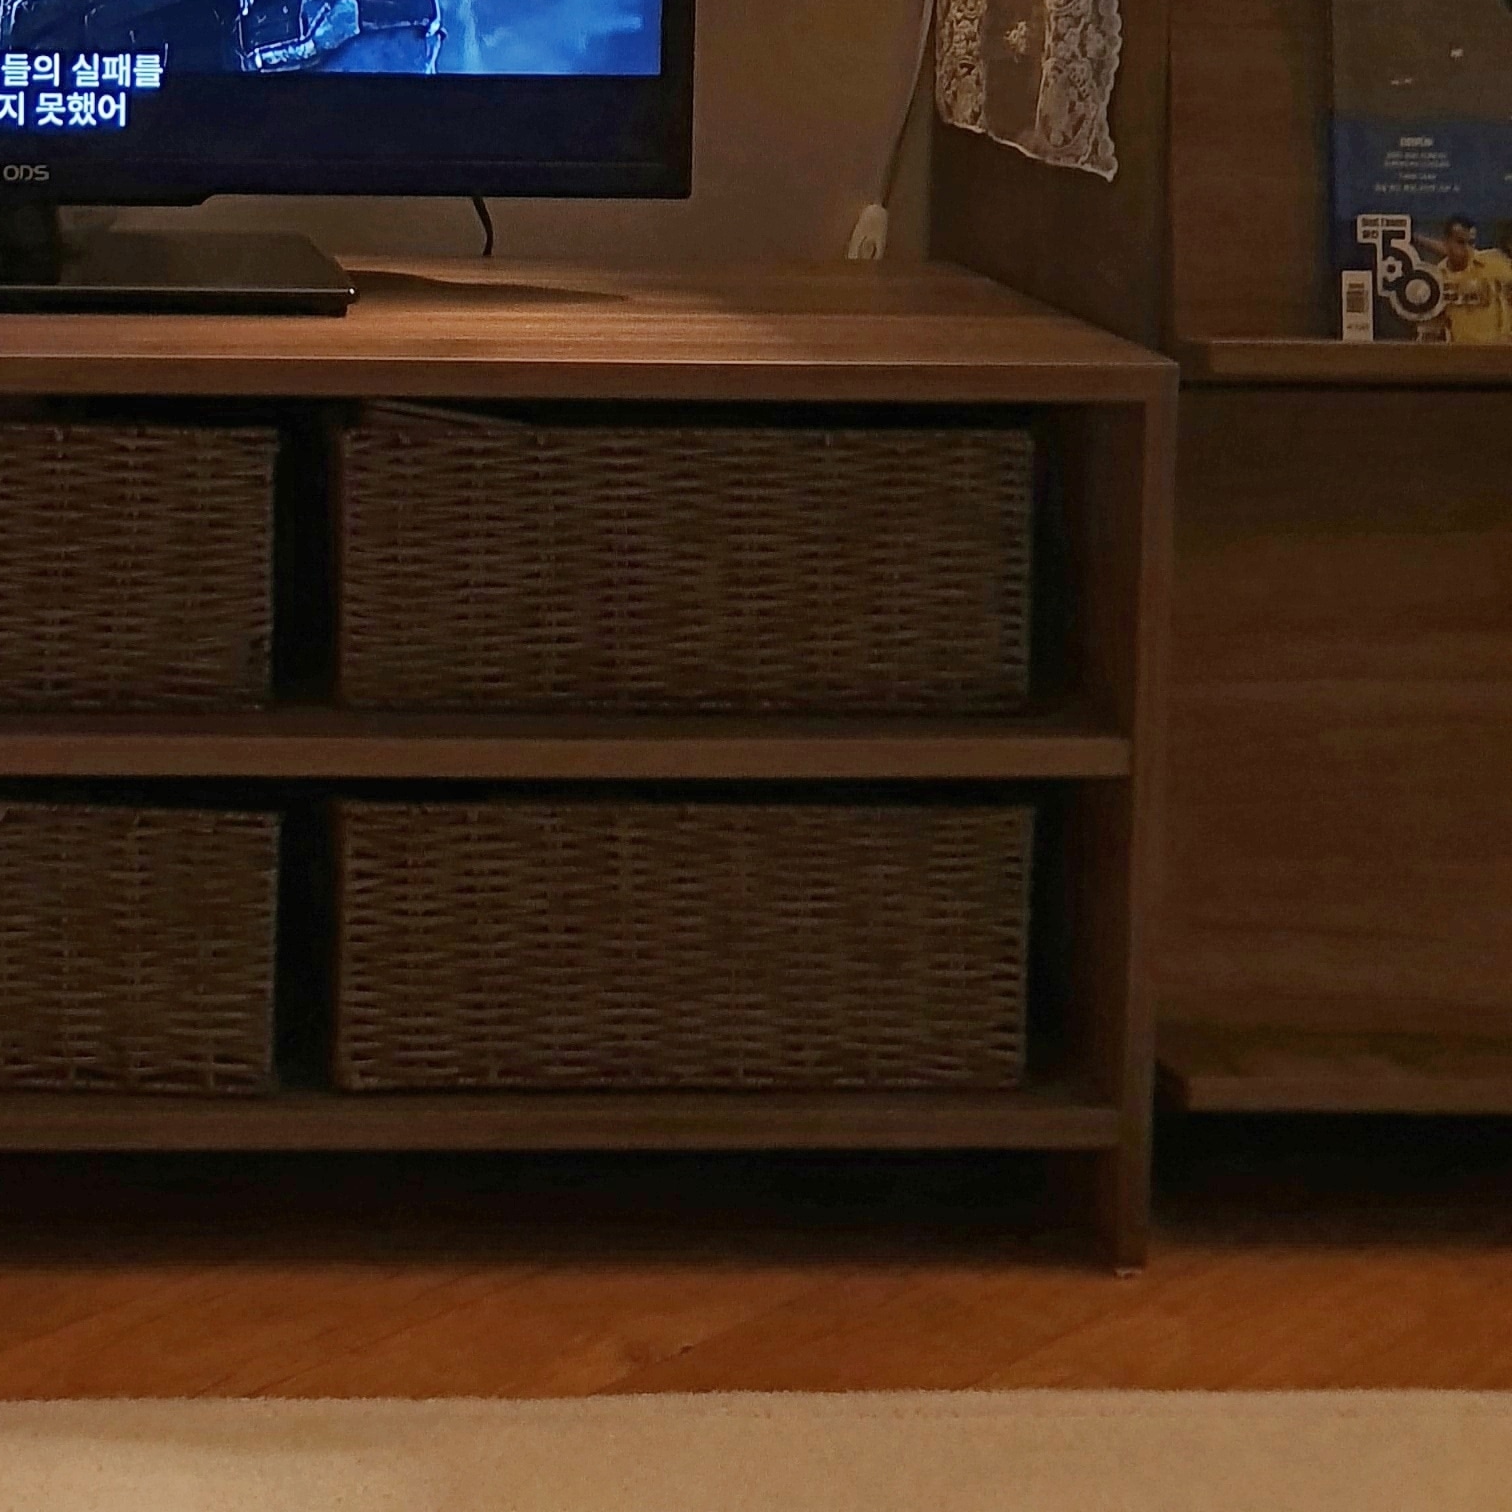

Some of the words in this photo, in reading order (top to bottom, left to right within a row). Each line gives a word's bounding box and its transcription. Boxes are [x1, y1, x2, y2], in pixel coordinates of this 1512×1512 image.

[72, 52, 163, 88] 실패를
[35, 91, 126, 127] 못했어
[3, 164, 50, 182] ODS
